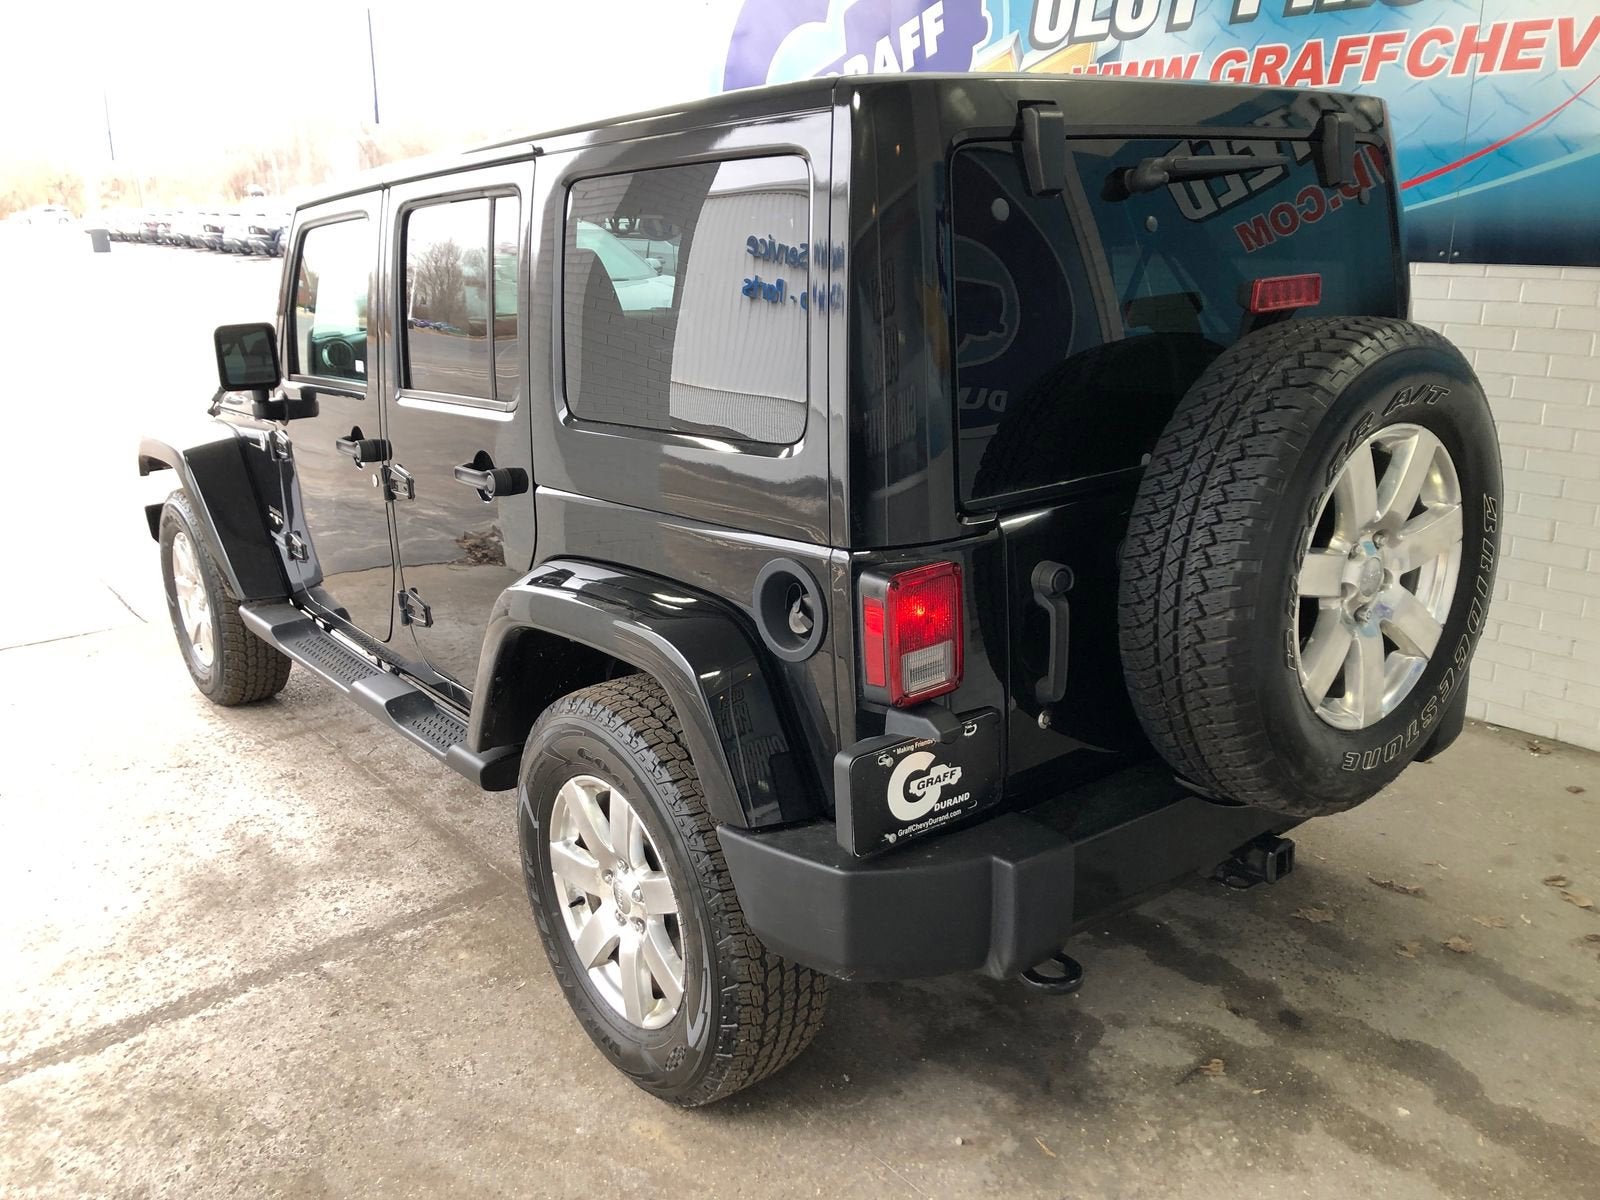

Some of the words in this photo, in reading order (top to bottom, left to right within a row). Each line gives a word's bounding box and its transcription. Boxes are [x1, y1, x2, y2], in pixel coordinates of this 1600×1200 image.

[826, 1, 944, 76] AFF
[1382, 383, 1452, 417] A/T
[1342, 493, 1498, 773] BRIDGESTONE
[916, 769, 958, 791] GRAFF
[933, 791, 971, 812] DURAND
[897, 808, 962, 837] GraffChevyDurand.com
